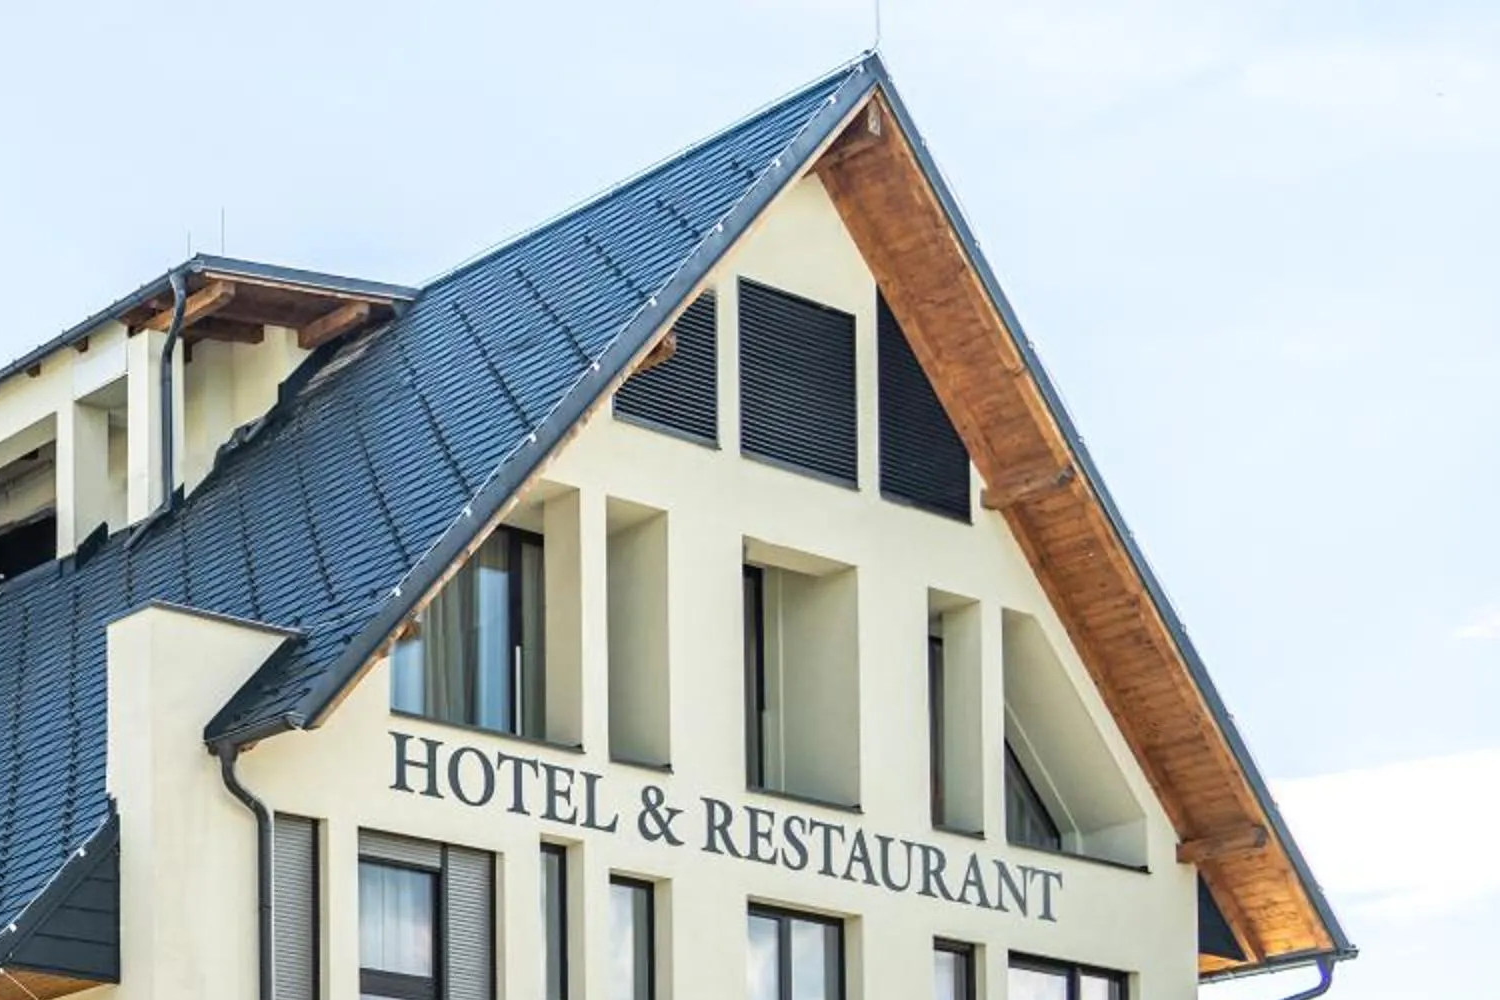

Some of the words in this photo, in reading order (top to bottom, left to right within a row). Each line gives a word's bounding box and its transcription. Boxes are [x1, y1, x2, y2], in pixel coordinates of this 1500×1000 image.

[388, 731, 619, 833] HOTEL
[637, 785, 685, 847] &
[700, 797, 1063, 923] RESTAURANT
